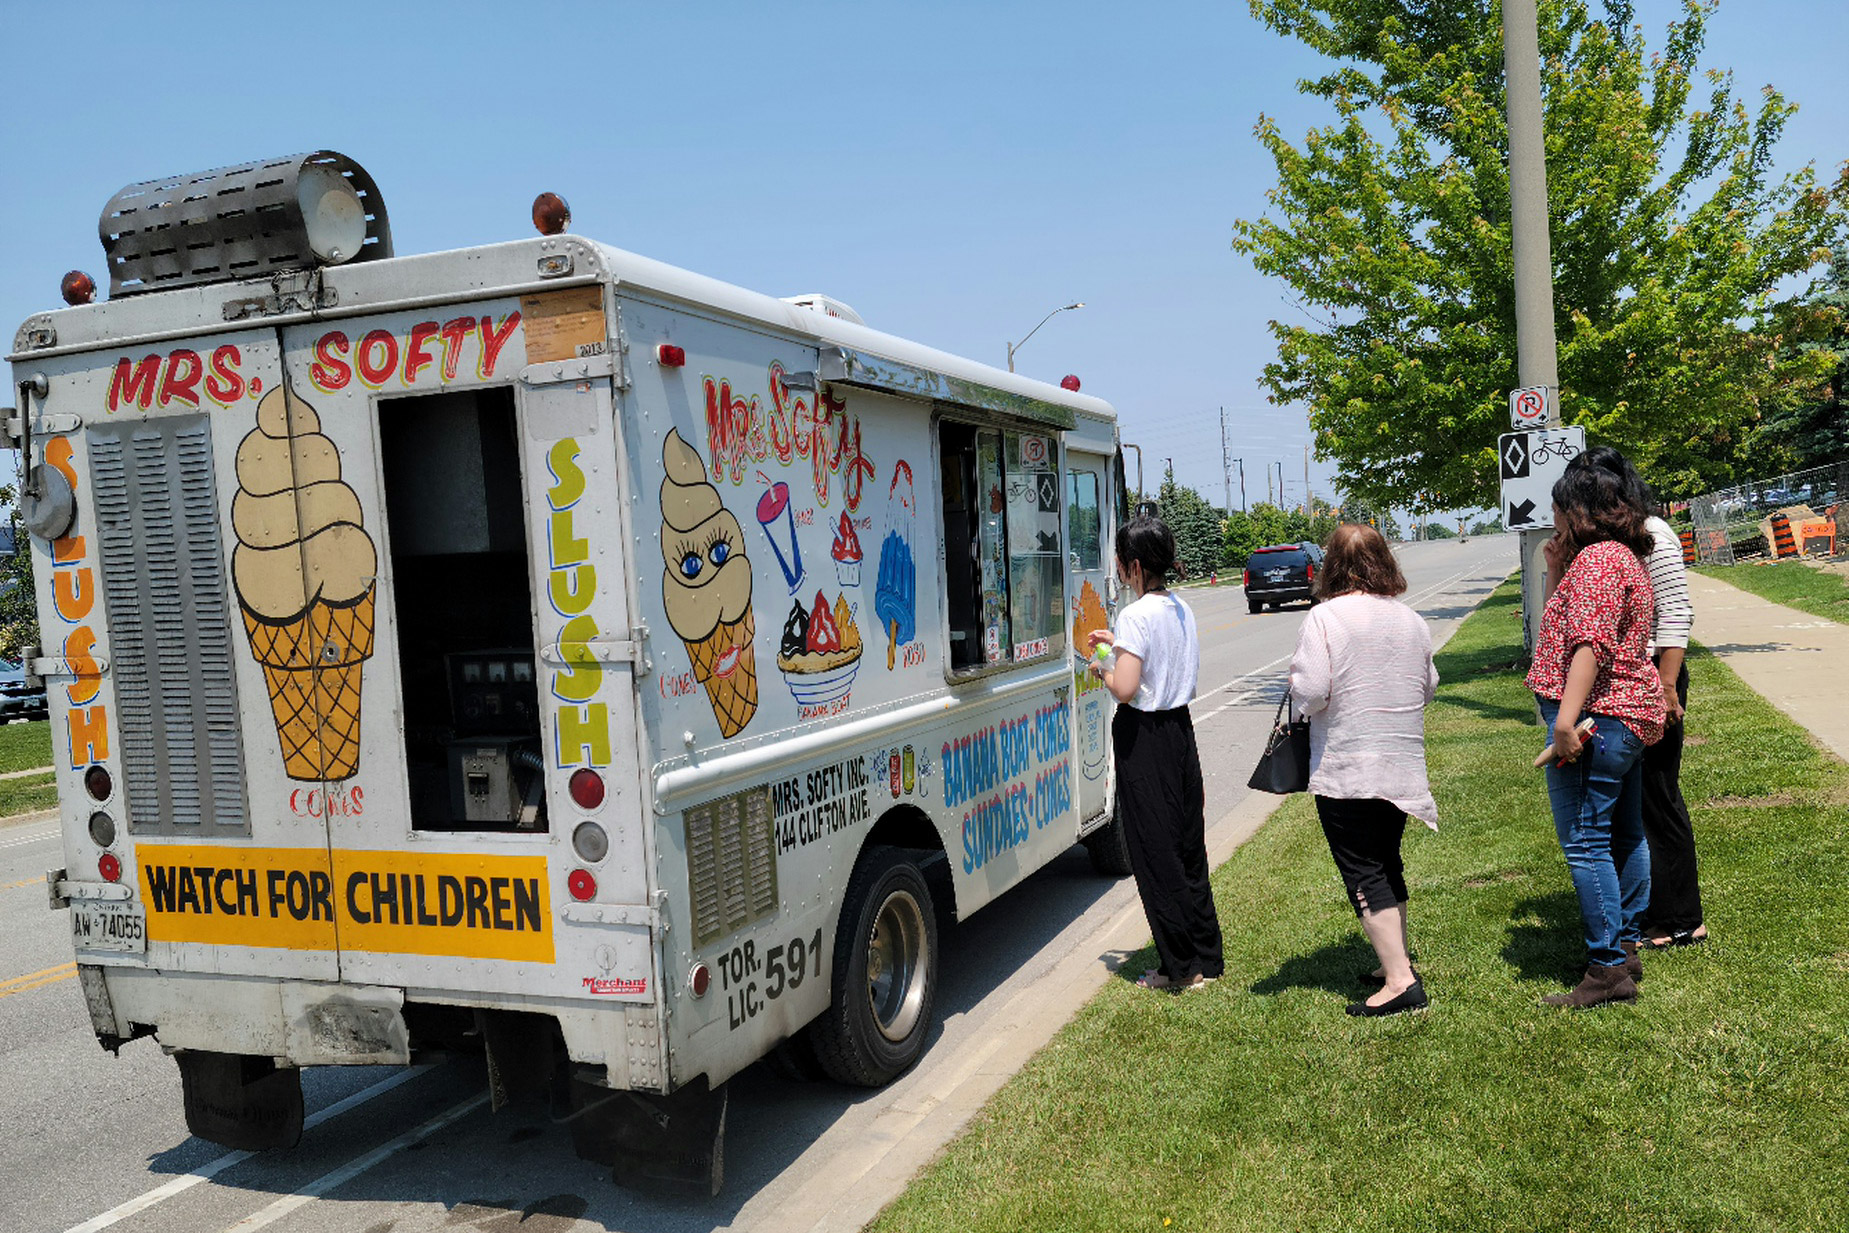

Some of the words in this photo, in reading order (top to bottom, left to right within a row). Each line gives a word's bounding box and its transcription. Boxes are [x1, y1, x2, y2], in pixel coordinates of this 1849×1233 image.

[106, 344, 262, 414] MRS.
[310, 311, 521, 393] SOFTY
[546, 437, 611, 769] SLUSH
[772, 777, 804, 819] MRS.
[807, 762, 844, 806] SOFTY
[847, 755, 870, 791] INC.
[942, 741, 1000, 808] BANANA
[775, 816, 796, 856] 144
[799, 796, 847, 846] CLIFTON
[849, 788, 871, 826] AVE.
[963, 781, 1030, 875] SUNDAES
[145, 864, 259, 917] WATCH
[266, 869, 334, 922] FOR
[346, 871, 542, 932] CHILDREN
[582, 976, 647, 989] Merchant
[717, 939, 762, 991] TOR.
[765, 927, 822, 999] 591
[728, 981, 764, 1032] LIC.
